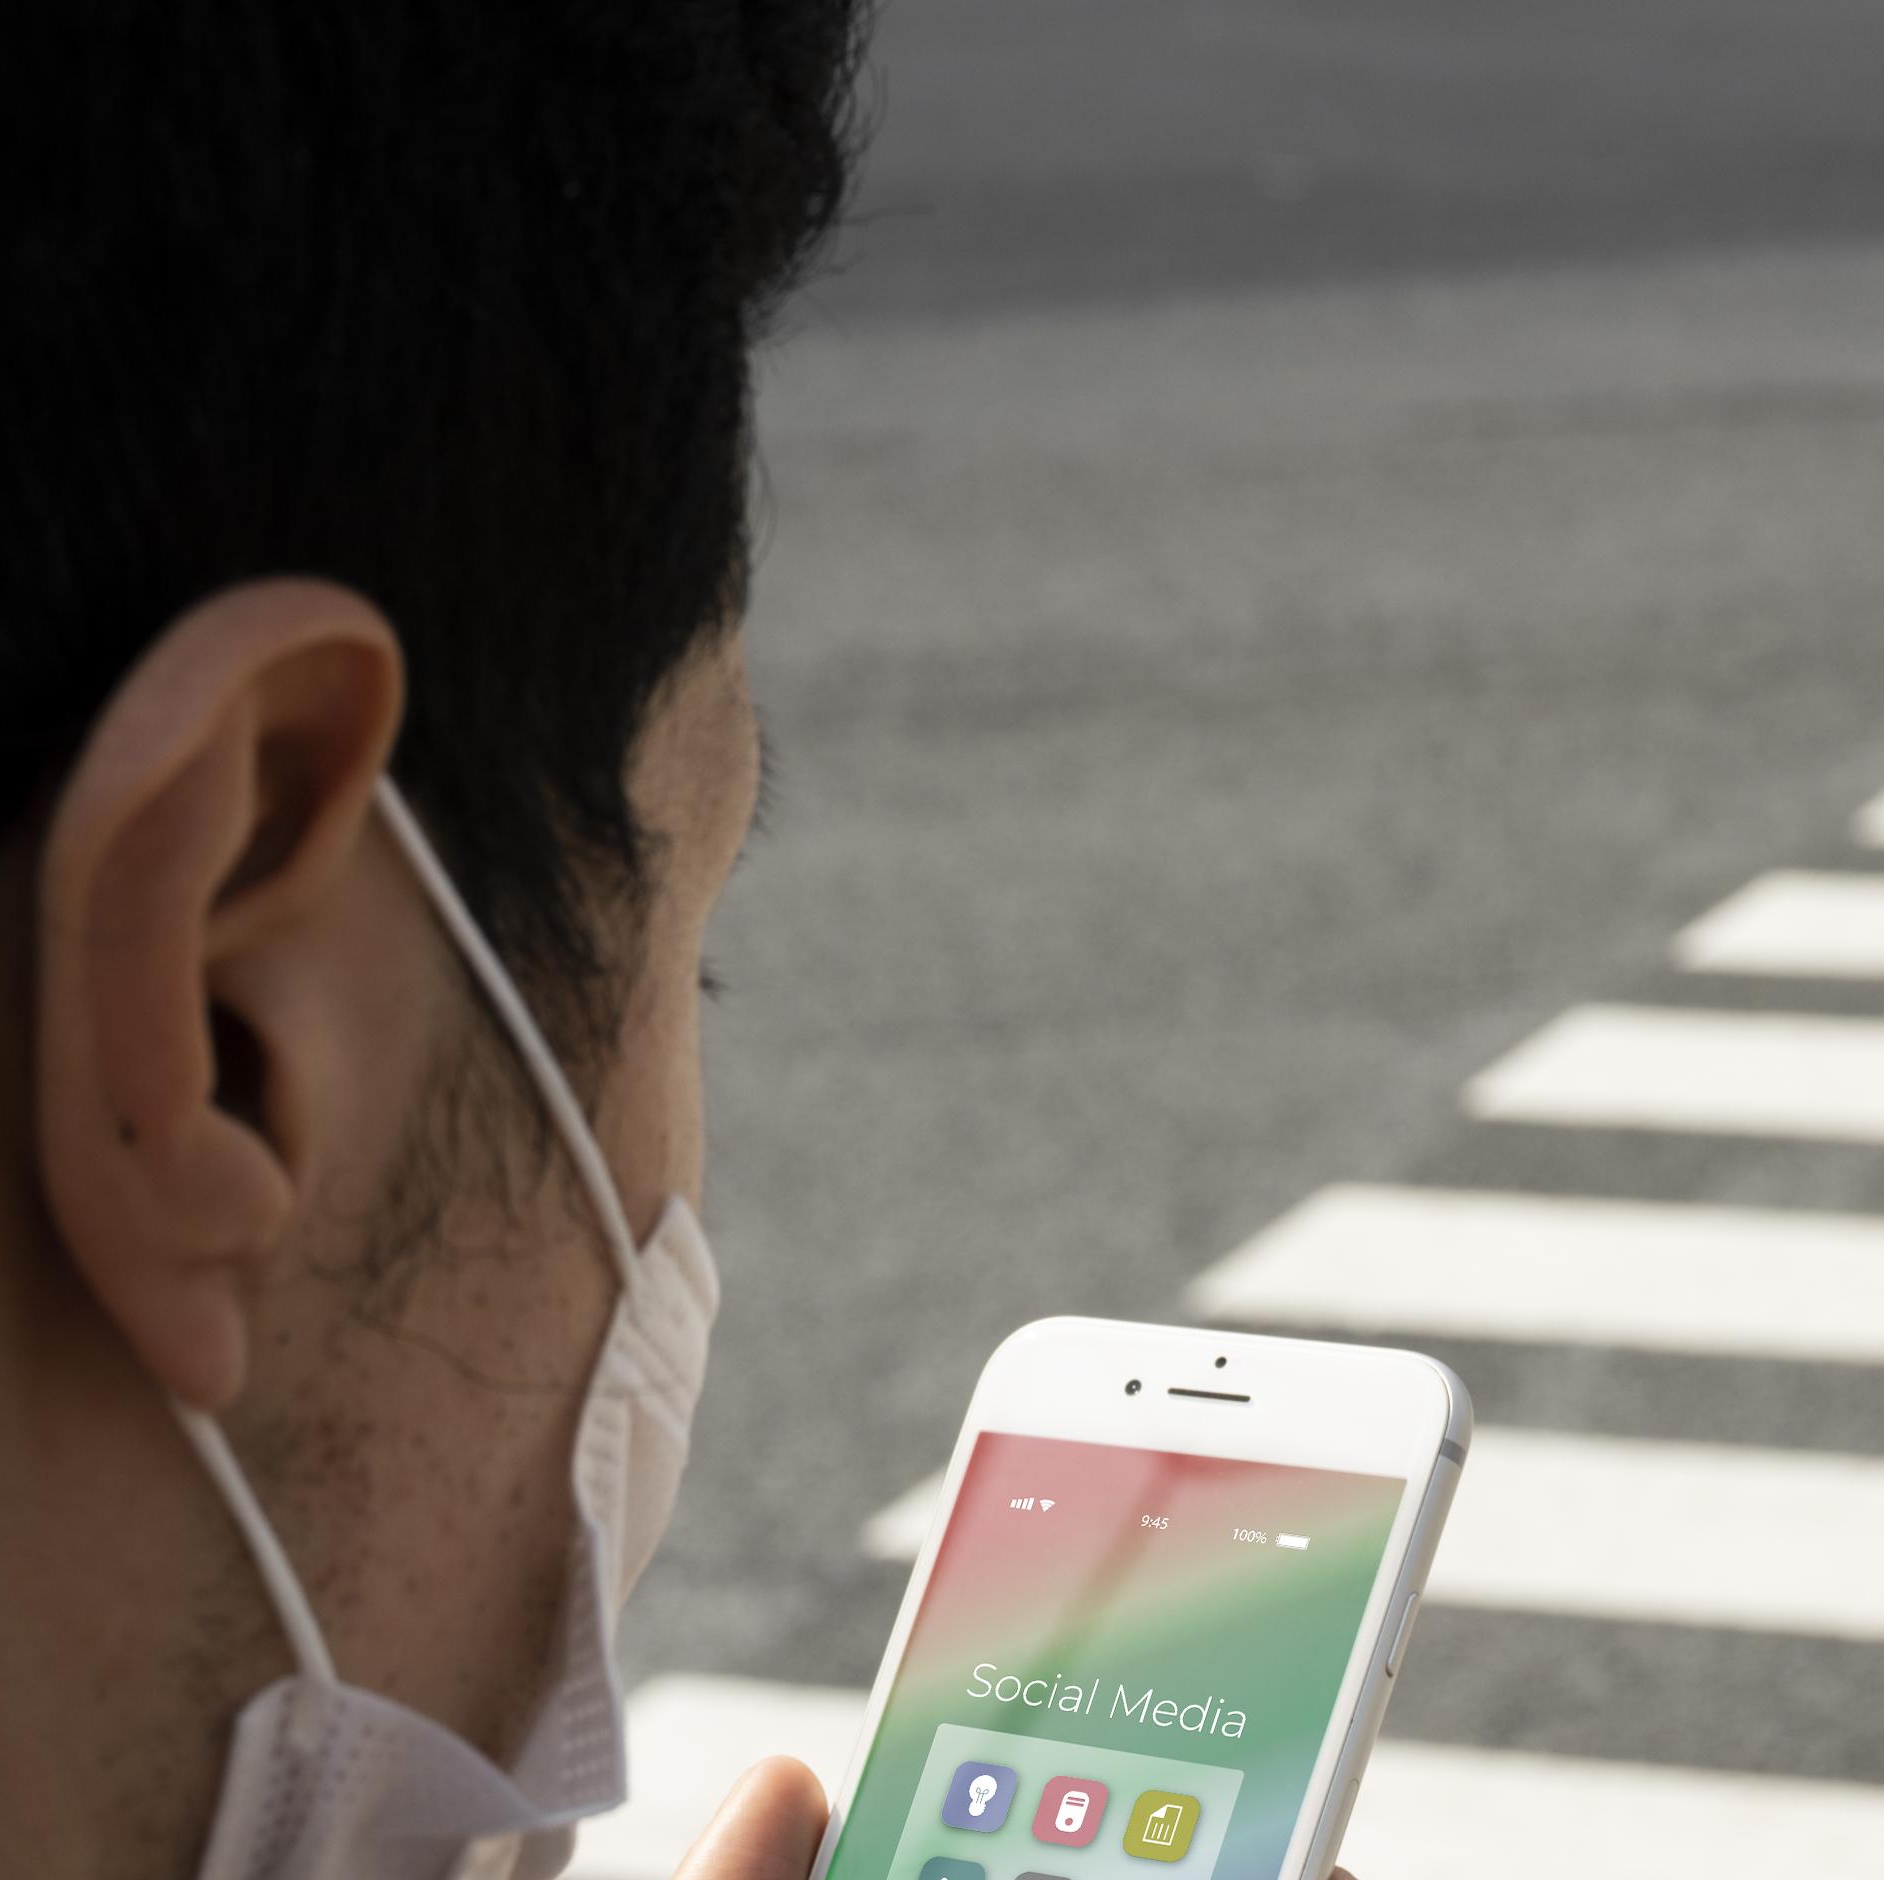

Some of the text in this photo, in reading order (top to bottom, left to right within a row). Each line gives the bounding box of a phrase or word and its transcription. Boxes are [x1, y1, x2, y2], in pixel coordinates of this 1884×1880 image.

[1140, 1514, 1170, 1530] 9:45
[1232, 1527, 1268, 1544] 100%
[966, 1663, 1248, 1740] Social Media
